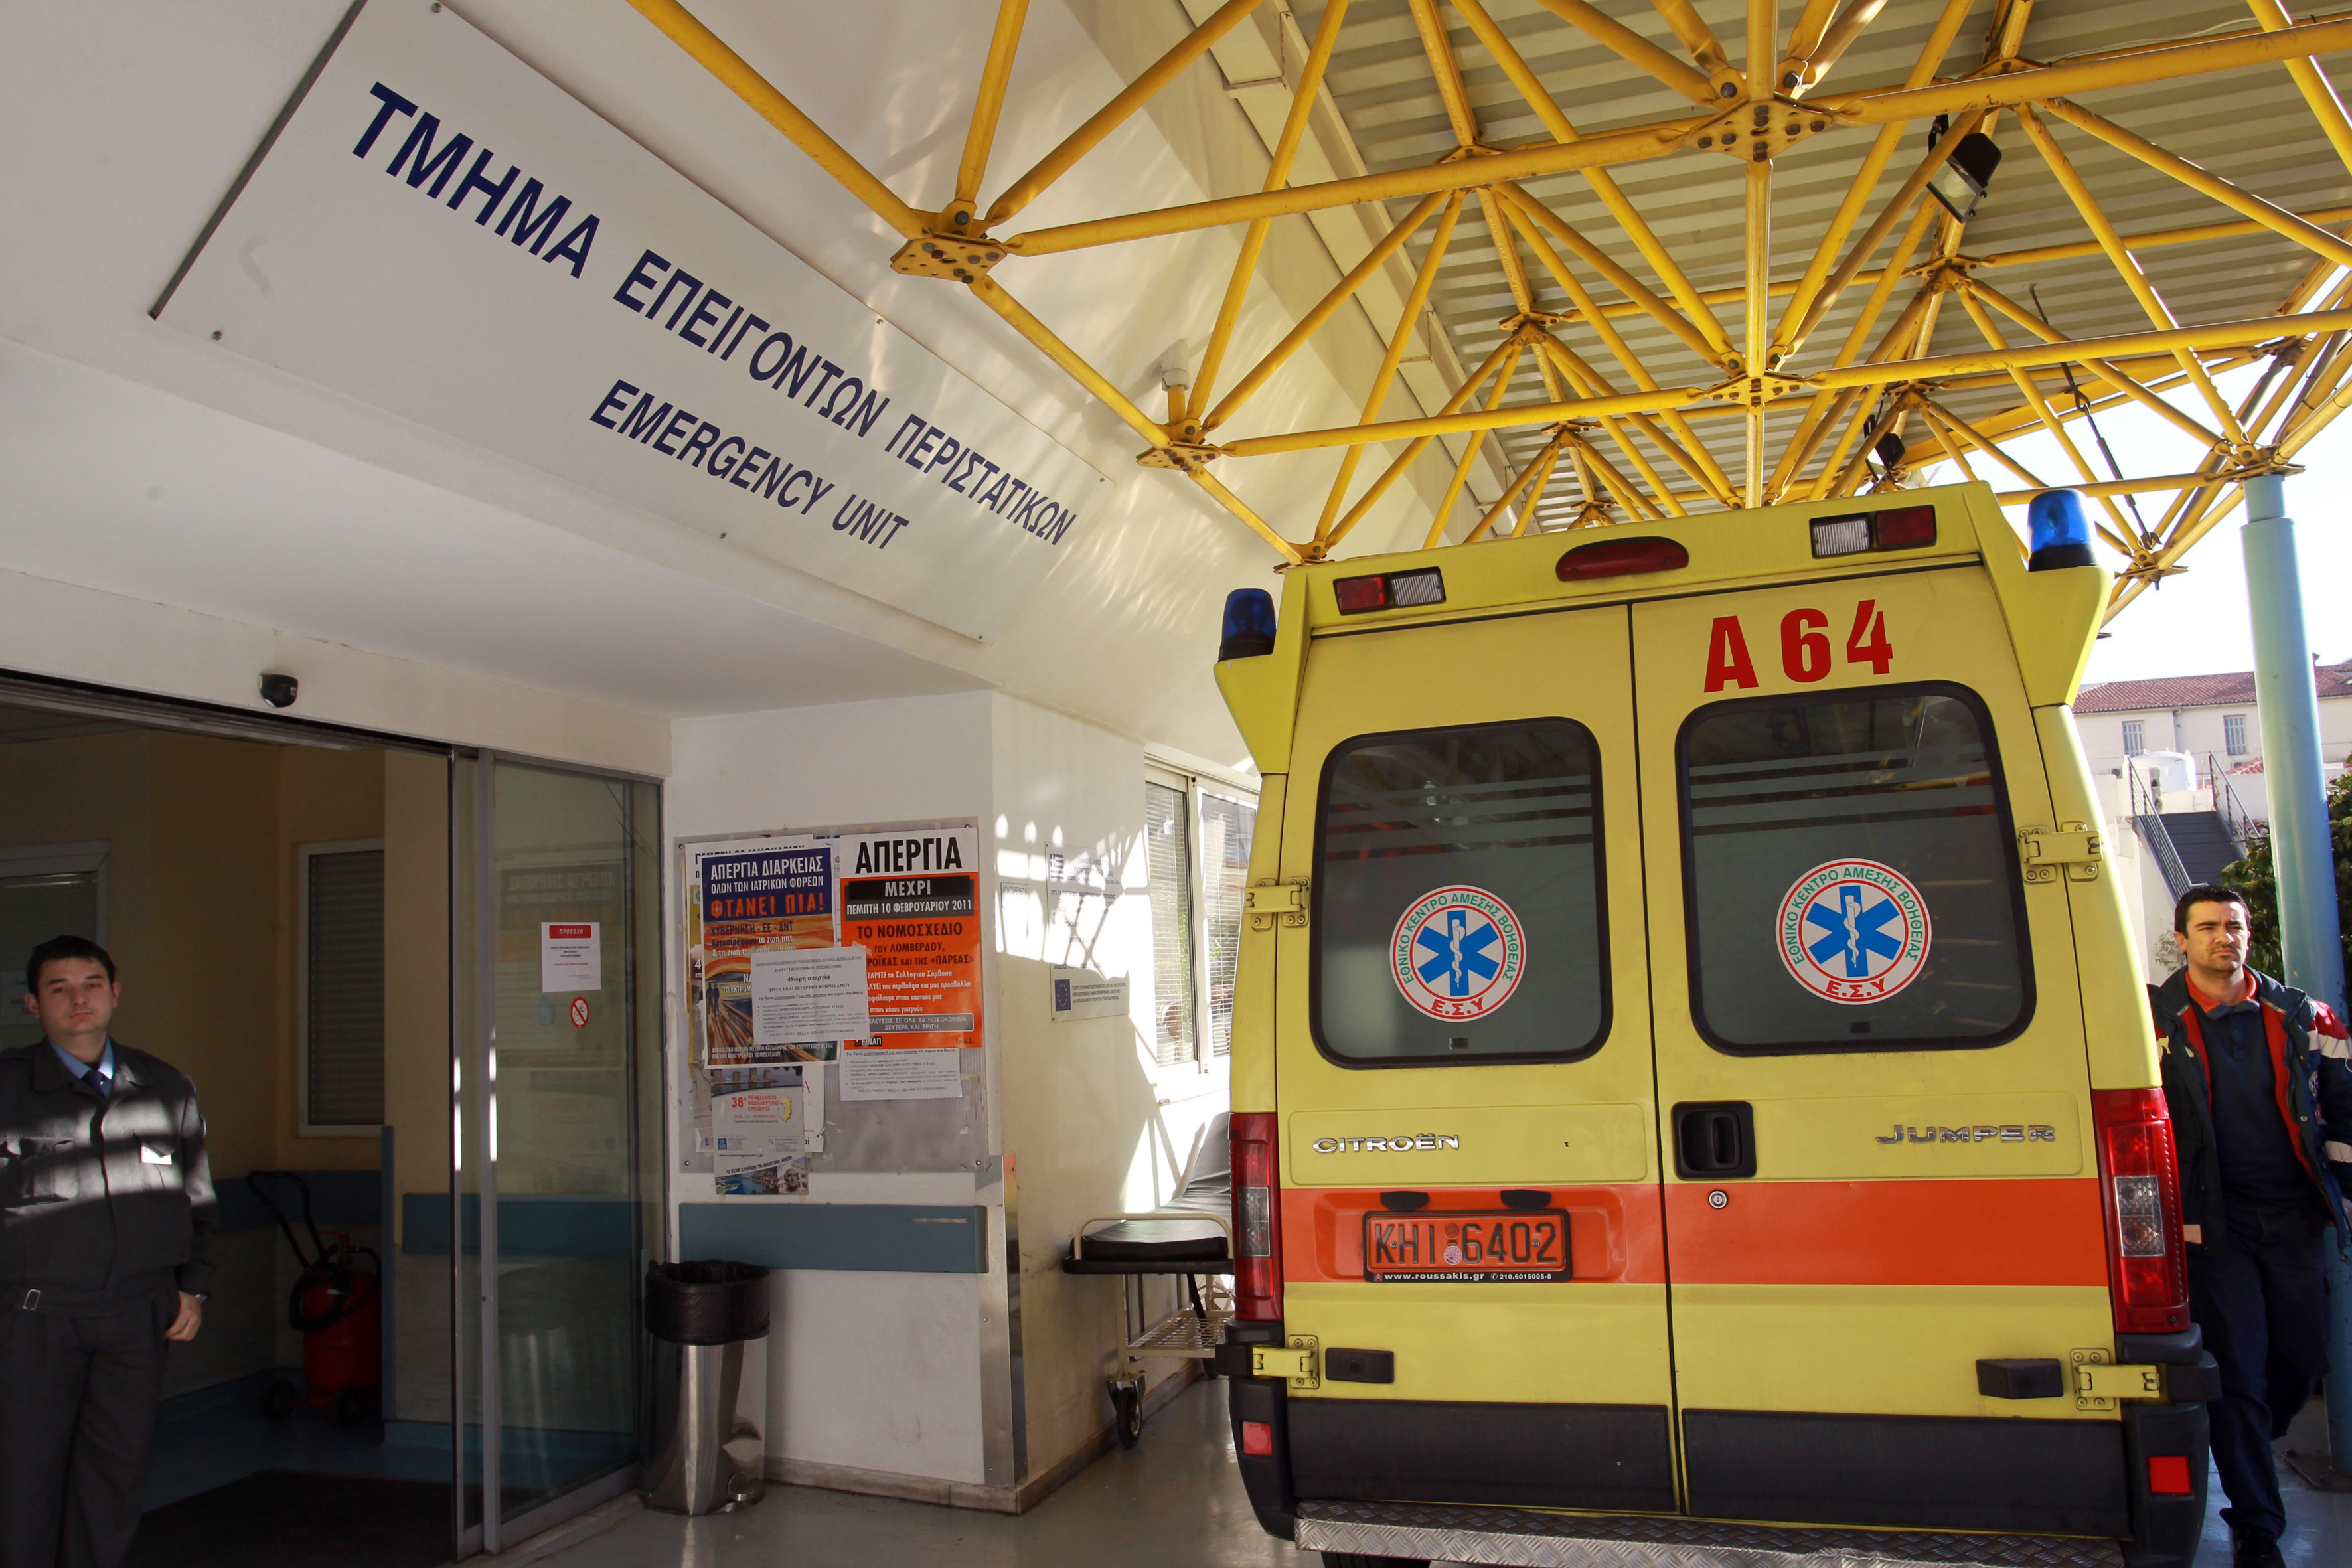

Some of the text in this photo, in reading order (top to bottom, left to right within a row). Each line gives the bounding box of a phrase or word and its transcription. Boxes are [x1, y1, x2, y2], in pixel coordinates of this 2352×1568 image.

[352, 82, 1077, 545] ΤΜΗΜΑ ΕΠΕΙΓΟΝΤΩΝ ΠΕΡΙΣΤΑΤΙΚΩΝ
[590, 379, 909, 549] EMERGENCY UNIT
[1780, 599, 1893, 683] 64
[855, 837, 962, 874] ΑΠΕΡΓΙΑ
[711, 862, 759, 880] ΑΠΕΡΓΙΑ
[762, 856, 823, 876] ΔΙΑΡΚΕΙΑΣ
[711, 876, 823, 894] ΟΛΩΝ ΤΩΝ ΙΑΤΡΙΚΩΝ ΦΟΡΕΩΝ
[885, 880, 931, 897] ΜΕΧΡΙ
[711, 892, 823, 919] ΦΤΑΝΕΙ ΠΙΑ!
[847, 900, 971, 915] ΠΕΜΠΤΗ 10 ΦΕΒΡΟΥΑΡΙΟΥ 2011
[1786, 867, 1922, 965] ΕΘΝΙΚΟ ΚΕΝΤΡΟ ΑΜΕΣΗΣ ΒΟΗΘΕΙΑΣ
[779, 921, 793, 932] ΔΝΤ
[857, 922, 963, 939] ΤΟ ΝΟΜΟΣΧΕΔΙΟ
[767, 935, 779, 943] ζωή
[781, 935, 793, 945] μας
[890, 942, 945, 953] ΛΟΜΒΕΡΔΟΥ,
[1398, 893, 1518, 984] ΕΘΝΙΚΟ ΚΕΝΤΡΟ ΑΜΕΣΗΣ ΒΟΗΘΕΙΑΣ
[866, 955, 898, 967] ΡΟΪΚΑΣ
[931, 955, 974, 964] «ΠΑΡΕΑΣ»
[896, 970, 925, 979] Συλλογική
[927, 969, 952, 979] Σύμβαση
[1826, 977, 1885, 998] Ε.Σ.Υ
[1431, 996, 1484, 1016] Ε.Σ.Υ
[1312, 1133, 1460, 1153] CITROËN
[1876, 1124, 2056, 1144] JUMPER
[1384, 1272, 1484, 1281] www.roussakis.gr
